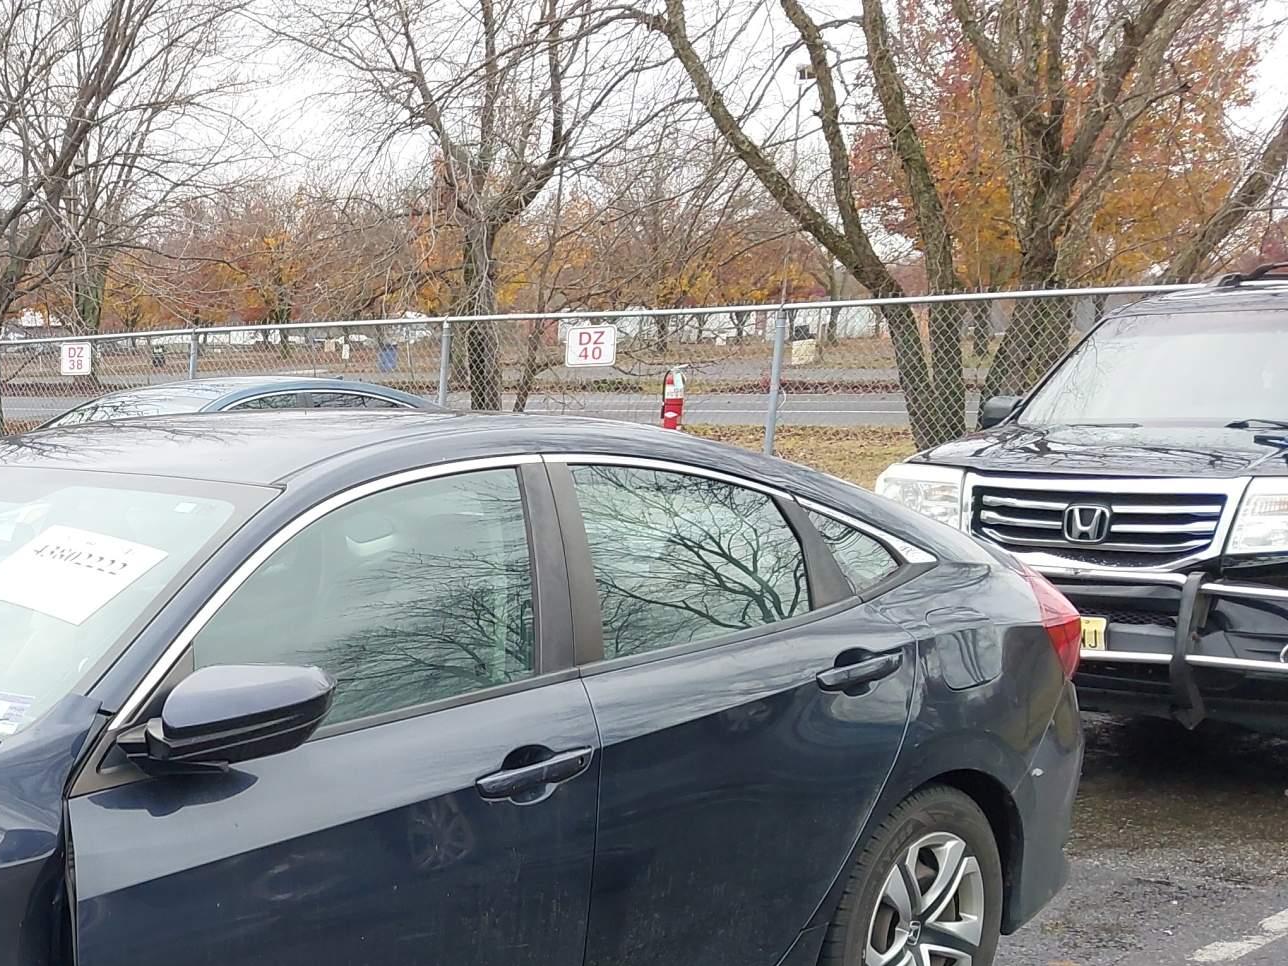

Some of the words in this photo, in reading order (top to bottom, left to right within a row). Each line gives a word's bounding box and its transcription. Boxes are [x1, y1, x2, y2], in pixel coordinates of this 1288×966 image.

[578, 330, 605, 346] DZ
[68, 346, 84, 358] DZ
[578, 346, 602, 360] 40
[68, 359, 83, 370] 38
